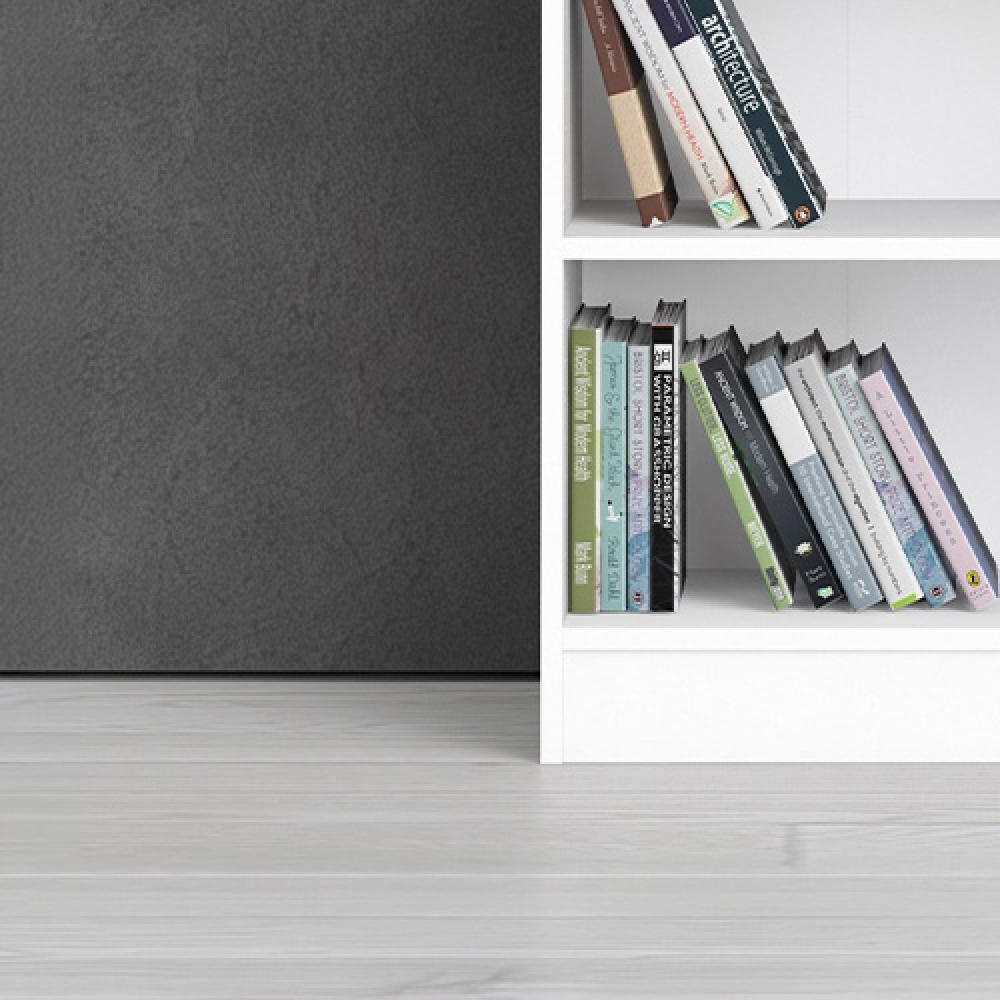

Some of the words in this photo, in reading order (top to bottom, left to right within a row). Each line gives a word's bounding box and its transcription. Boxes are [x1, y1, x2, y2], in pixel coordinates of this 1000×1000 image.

[702, 13, 760, 113] architecture
[632, 399, 642, 434] SHORT
[653, 373, 661, 411] WITH
[663, 373, 671, 470] PARAMETRIC
[852, 415, 878, 450] SHORT
[653, 415, 661, 523] GRASSHOPPER
[663, 473, 671, 528] DESIGN
